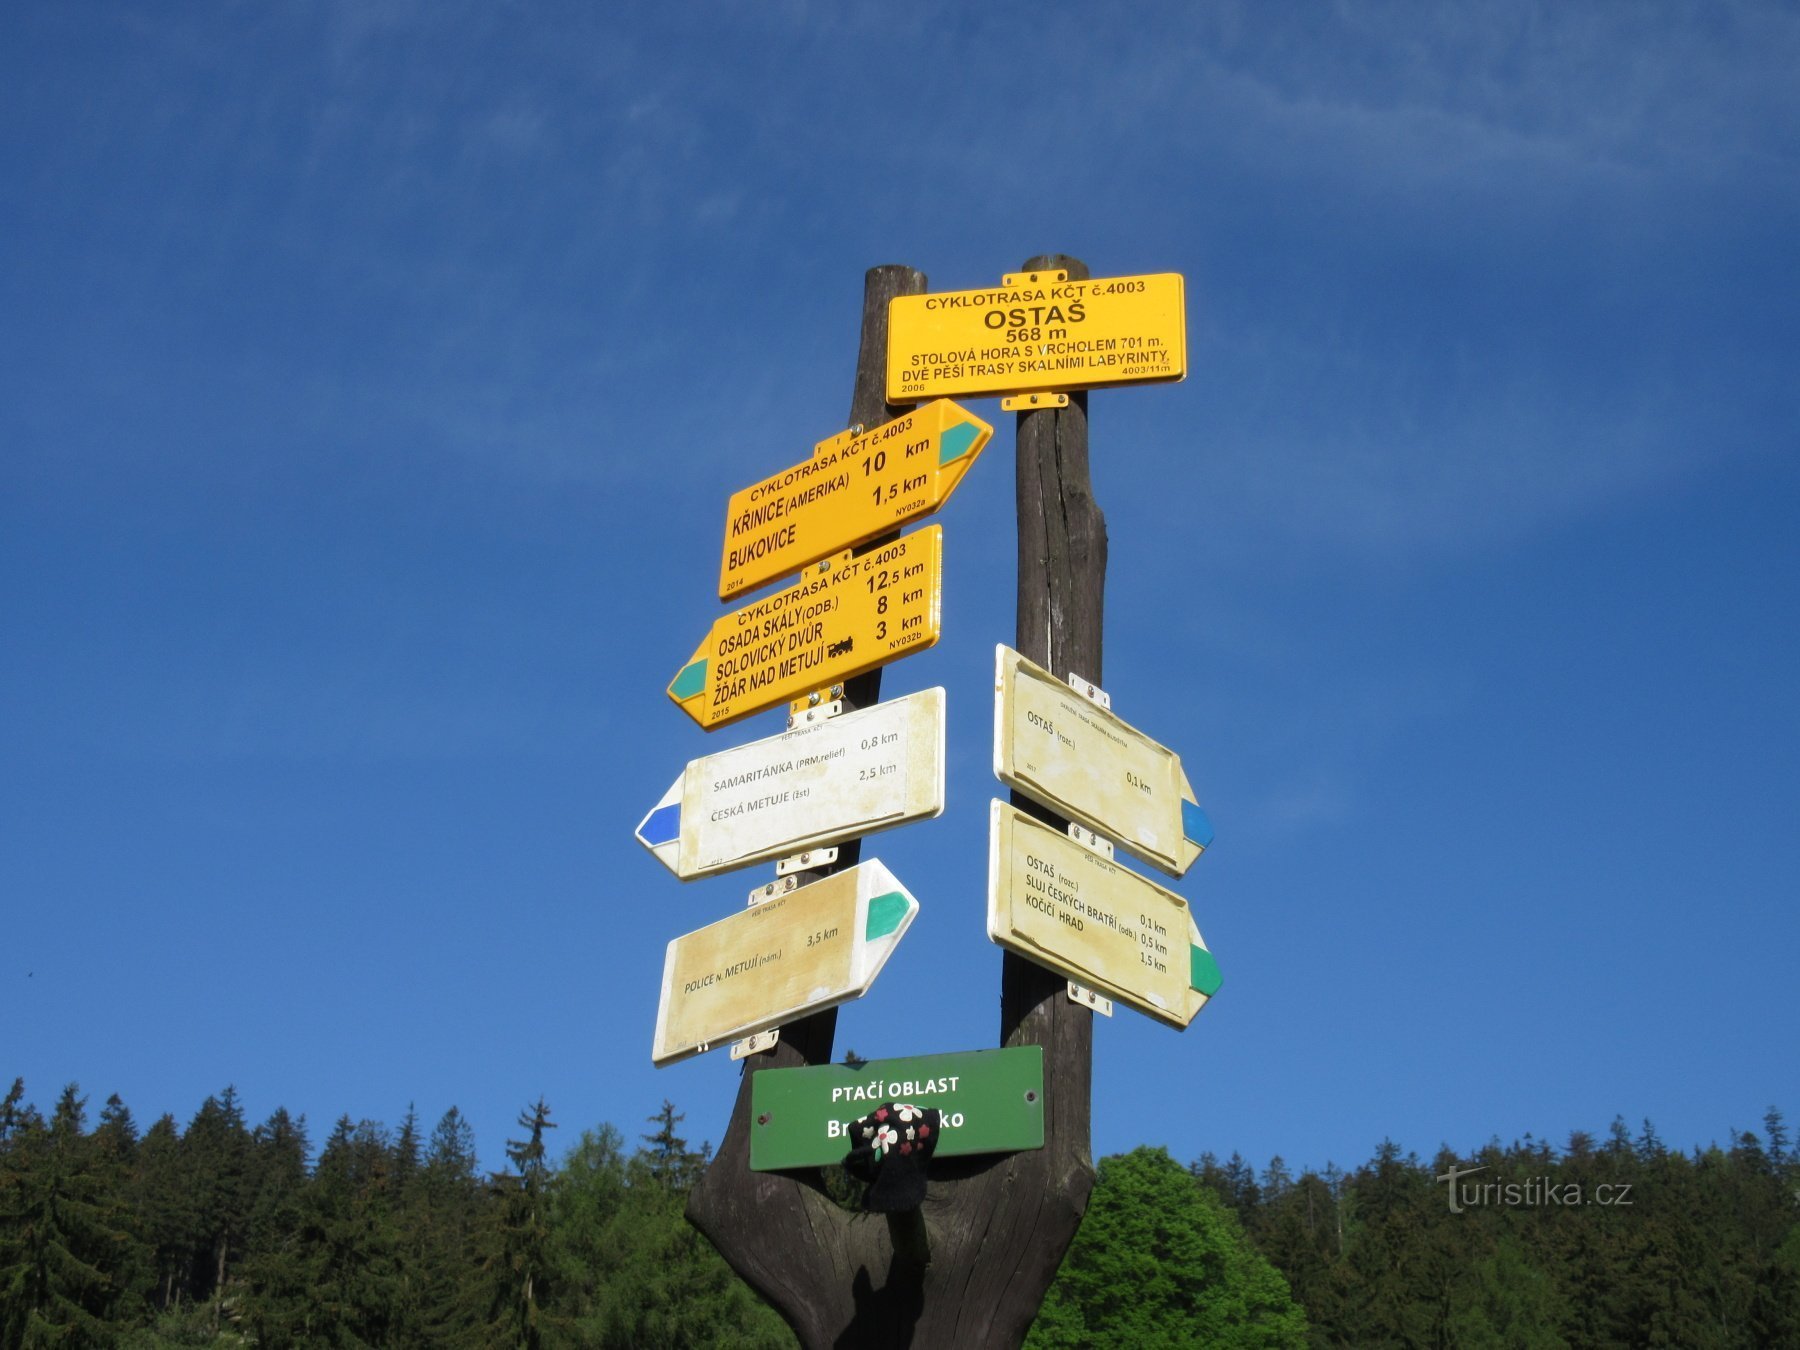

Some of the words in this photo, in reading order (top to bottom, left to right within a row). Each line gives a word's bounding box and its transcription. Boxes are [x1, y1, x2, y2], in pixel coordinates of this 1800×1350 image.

[925, 288, 1046, 310] CYKLOTRASA
[1051, 283, 1087, 301] KČT
[1091, 281, 1146, 296] č.4003
[984, 299, 1086, 330] OSTAŠ
[1006, 327, 1042, 344] 568
[1049, 328, 1068, 340] m
[901, 384, 925, 393] 2006
[1122, 364, 1171, 376] 4003/11m
[902, 366, 930, 382] DVĚ
[934, 363, 964, 380] PĚŠÍ
[969, 361, 1014, 376] TRASY
[1018, 355, 1085, 374] SKALNÍMI
[911, 347, 977, 366] STOLOVÁ
[980, 346, 1020, 361] HORA
[1024, 346, 1034, 358] S
[1037, 338, 1117, 356] VRCHOLEM
[1121, 337, 1143, 349] 701
[1148, 338, 1164, 348] m.
[750, 453, 838, 502] CYKLOTRASA
[841, 438, 869, 460] KČT
[871, 418, 913, 447] č.4003
[862, 451, 886, 478] 10
[905, 438, 930, 459] km
[726, 578, 744, 592] 2014
[895, 500, 926, 518] NY032a
[728, 523, 797, 572] BUKOVICE
[872, 486, 898, 508] 1,5
[903, 474, 928, 494] km
[718, 624, 760, 658] OSADA
[866, 570, 900, 596] 12,5
[903, 561, 924, 580] km
[738, 578, 828, 626] CYKLOTRASA
[832, 564, 860, 587] KČT
[863, 543, 907, 573] č.4003
[712, 676, 747, 708] ŽĎÁR
[749, 666, 776, 694] NAD
[778, 640, 825, 680] METUJÍ
[875, 620, 888, 642] 3
[901, 613, 923, 632] km
[715, 634, 786, 682] SOLOVICKÝ
[788, 622, 824, 648] DVŮR
[876, 595, 889, 616] 8
[902, 586, 924, 606] km
[711, 706, 730, 720] 2015
[888, 631, 922, 650] NY032b
[711, 803, 745, 823] ČESKÁ
[747, 790, 790, 814] METUJE
[858, 766, 877, 782] 2,5
[878, 761, 897, 776] km
[713, 760, 794, 792] SAMARITÁNKA
[860, 736, 879, 752] 0,8
[881, 730, 899, 746] km
[1027, 710, 1054, 735] OSTAŠ
[1126, 771, 1139, 788] 0,1
[1140, 779, 1152, 796] km
[1025, 893, 1056, 918] KOČIČÍ
[1059, 910, 1084, 932] HRAD
[1140, 951, 1153, 968] 1,5
[1154, 958, 1167, 974] km
[1026, 855, 1055, 878] OSTAŠ
[1140, 914, 1152, 930] 0,1
[1154, 920, 1167, 936] km
[1026, 874, 1046, 895] SLUJ
[1047, 883, 1086, 914] ČESKÝCH
[1087, 905, 1118, 930] BRATŘÍ
[1141, 932, 1154, 949] 0,5
[1154, 939, 1168, 956] km
[684, 973, 716, 995] POLICE
[725, 953, 760, 978] METUJÍ
[806, 932, 822, 948] 3,5
[823, 926, 839, 941] km
[832, 1080, 884, 1103] PTAČÍ
[888, 1076, 960, 1099] OBLAST
